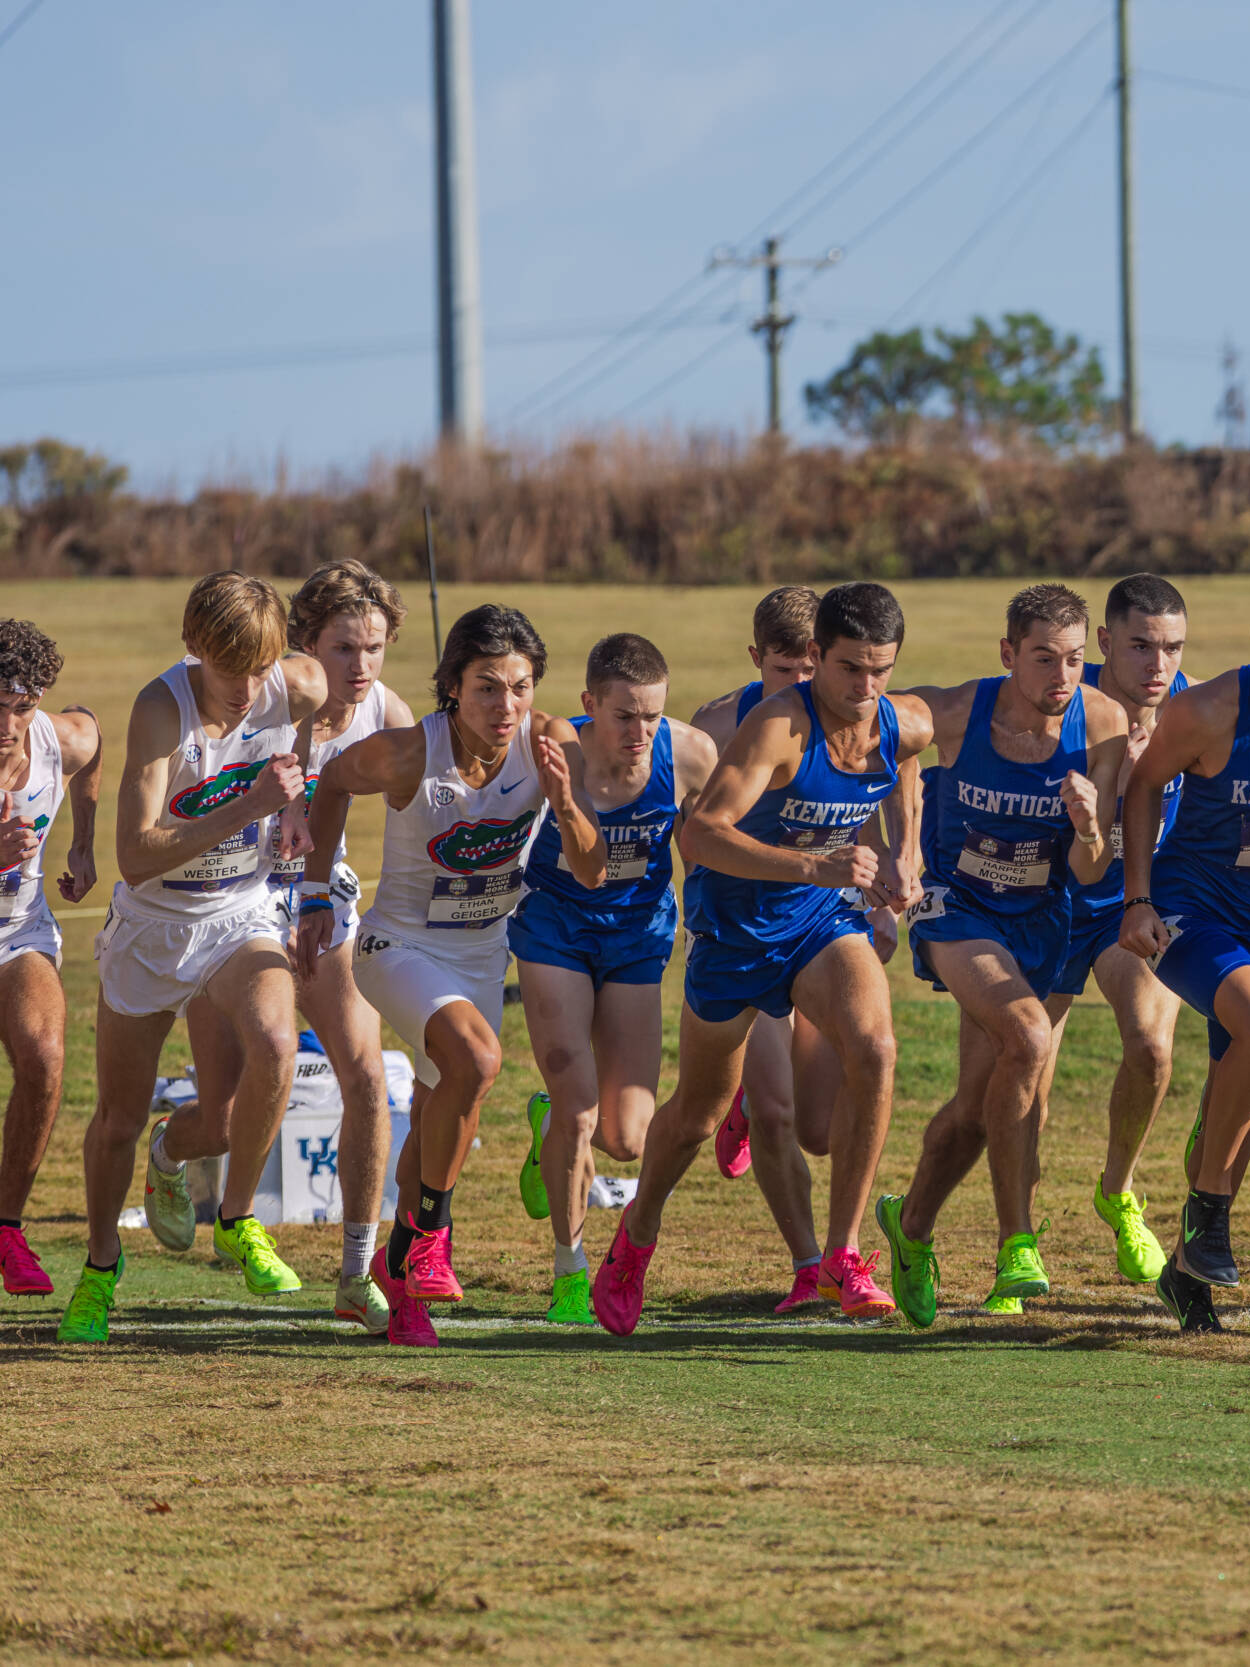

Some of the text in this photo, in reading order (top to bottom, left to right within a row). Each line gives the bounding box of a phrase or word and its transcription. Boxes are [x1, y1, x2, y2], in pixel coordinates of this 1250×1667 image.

[436, 790, 453, 804] SEC
[958, 780, 1068, 818] KENTUCK
[1014, 848, 1039, 856] MEANS
[201, 857, 223, 867] JOE
[272, 861, 305, 872] RATT
[983, 860, 1028, 875] HARPER
[184, 865, 239, 879] WESTER
[979, 868, 1027, 885] MOORE
[459, 898, 495, 909] ETHAN
[451, 906, 499, 920] GEIGER
[296, 1063, 328, 1079] FIELD
[296, 1137, 338, 1176] UK
